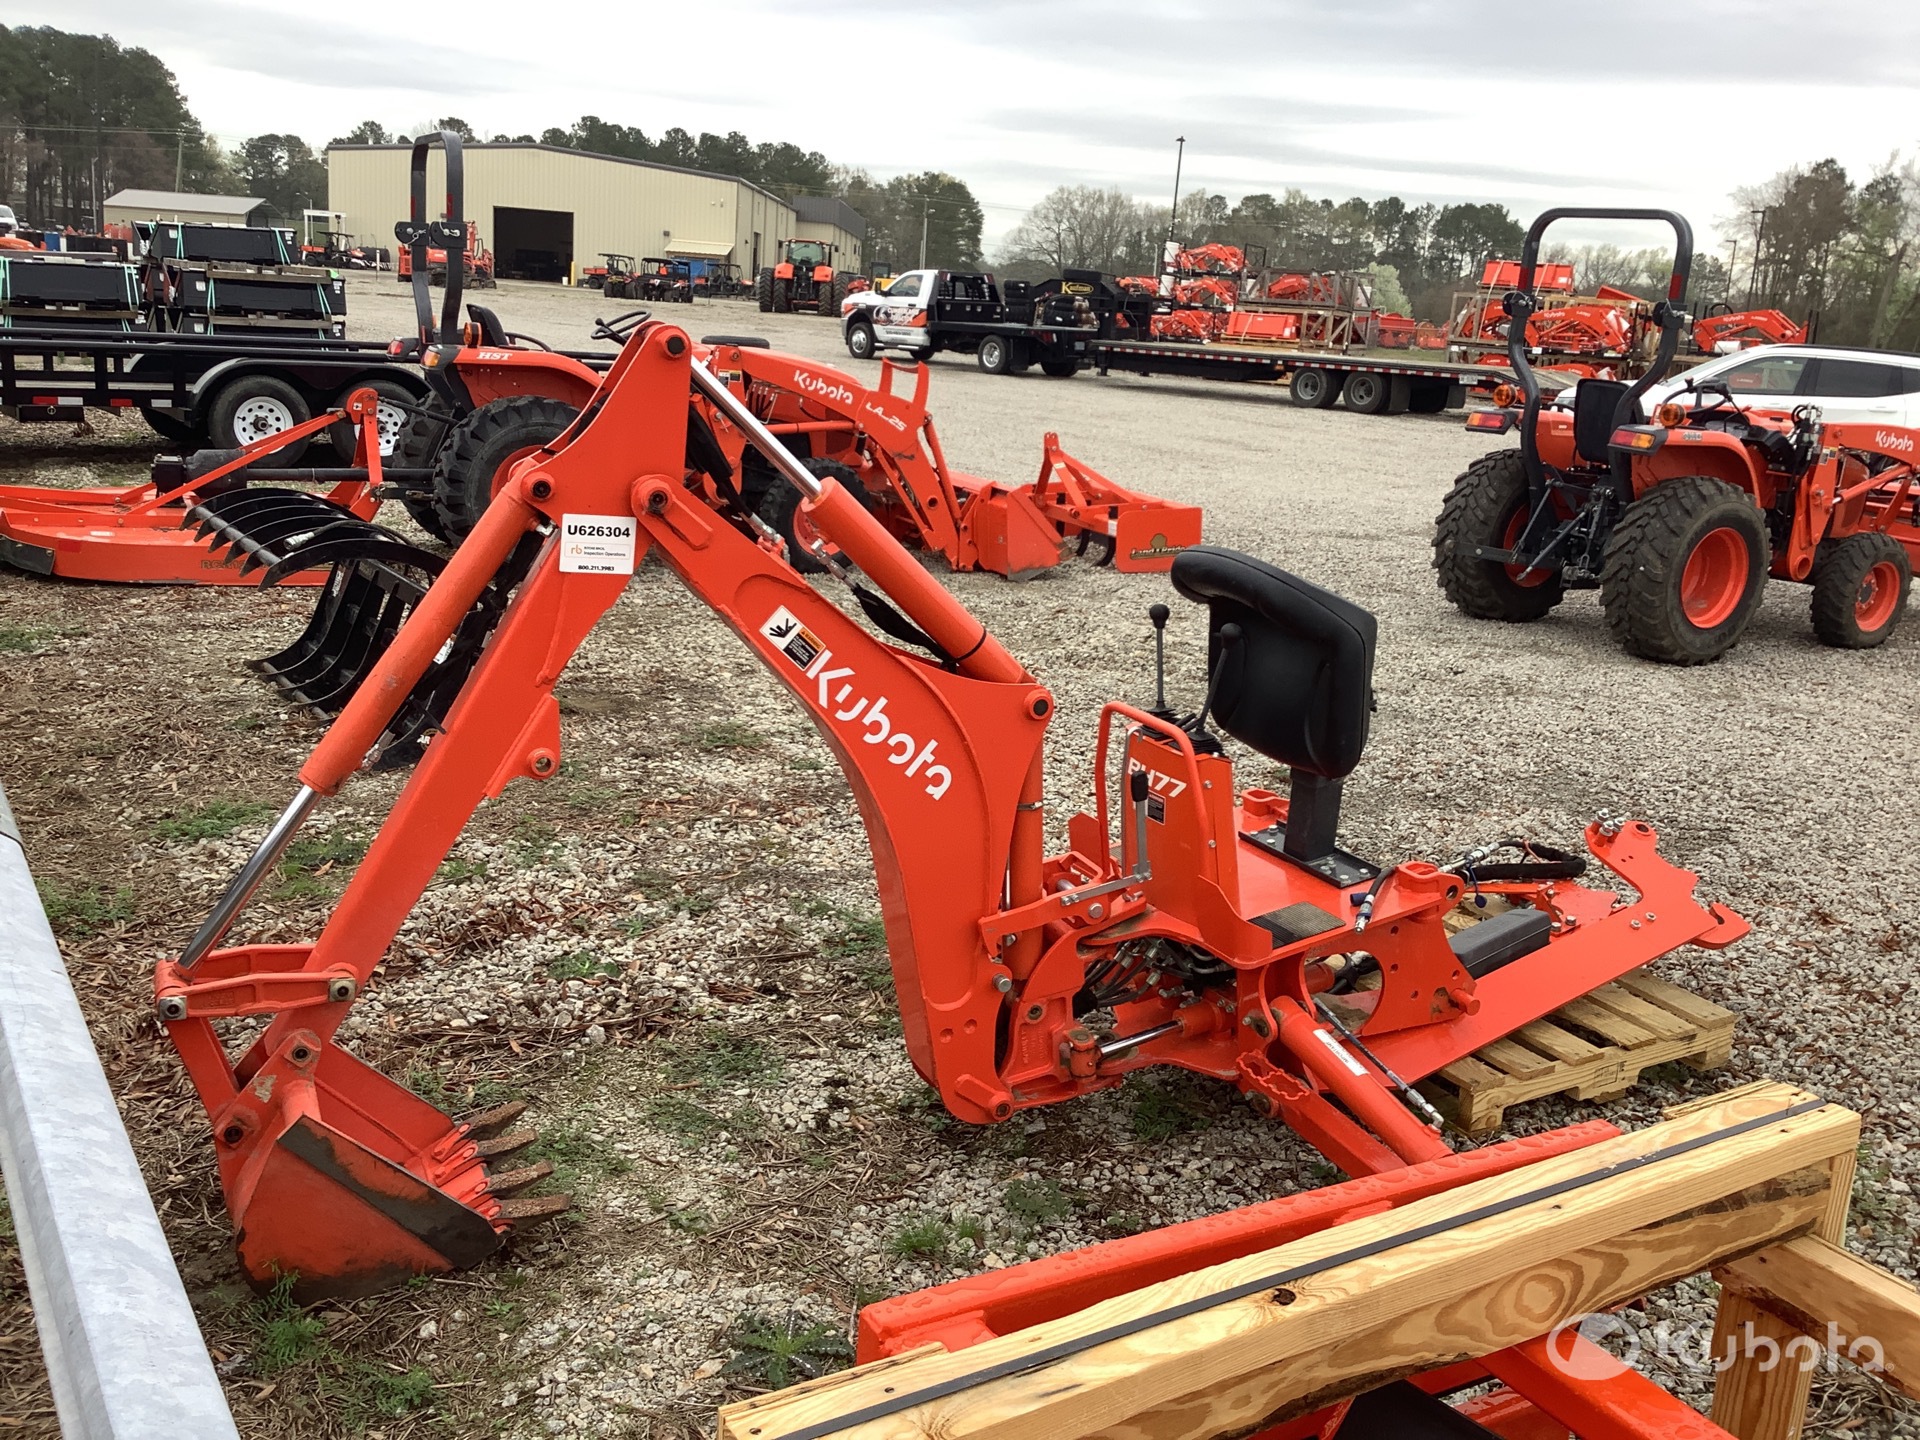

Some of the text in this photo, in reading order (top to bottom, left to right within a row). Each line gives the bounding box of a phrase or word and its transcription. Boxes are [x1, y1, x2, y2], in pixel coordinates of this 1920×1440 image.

[477, 351, 513, 361] HST
[793, 369, 853, 405] Kubota
[1875, 430, 1914, 452] Kubota
[567, 524, 631, 538] U626304
[805, 649, 952, 801] Kubota
